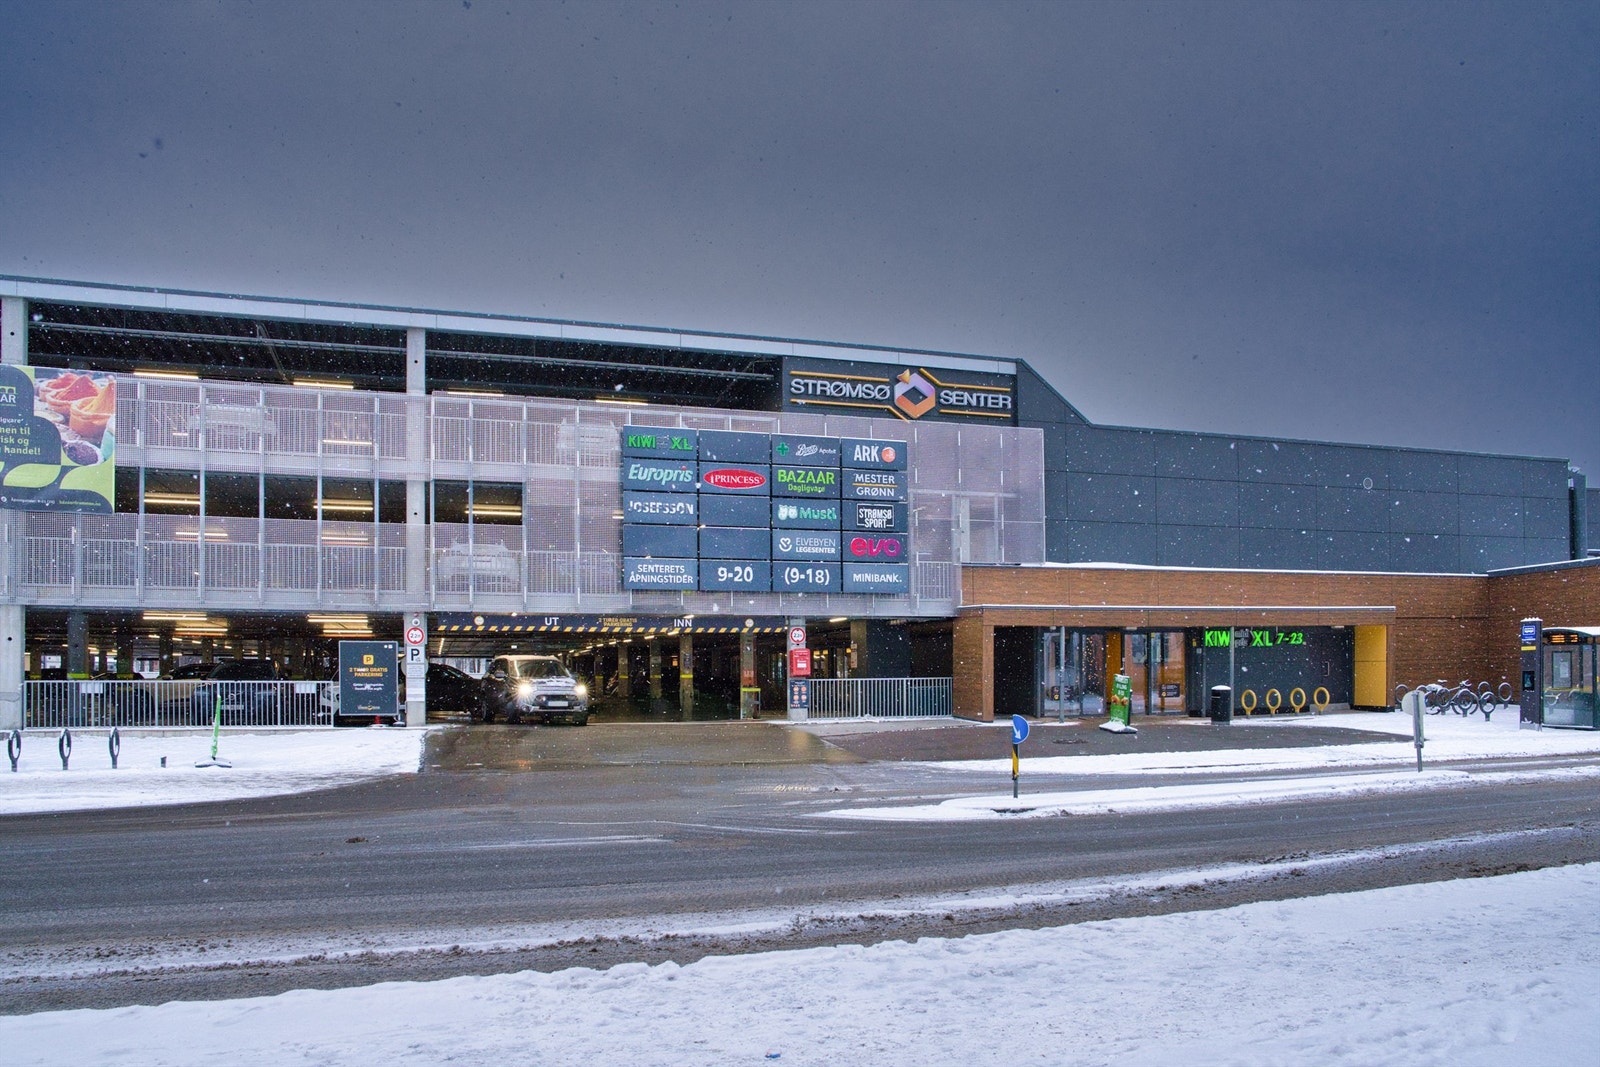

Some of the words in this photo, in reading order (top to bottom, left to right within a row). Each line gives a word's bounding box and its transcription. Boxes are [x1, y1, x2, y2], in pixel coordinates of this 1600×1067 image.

[789, 378, 890, 400] STRØMSØ
[940, 390, 1012, 409] SENTER
[20, 427, 31, 435] til
[17, 438, 29, 446] og
[628, 434, 656, 448] KIWI
[670, 436, 693, 450] XL
[4, 445, 41, 455] handel!
[853, 444, 880, 462] ARK
[628, 464, 693, 485] Europris
[714, 474, 760, 484] PRINCESS
[777, 469, 835, 484] BAZAAR
[854, 473, 895, 484] MESTER
[856, 486, 895, 497] GRØNN
[628, 500, 694, 514] JOSEFSSON
[800, 506, 837, 520] Musti
[858, 508, 892, 519] STRØMSØ
[864, 519, 887, 528] SPORT
[795, 537, 836, 547] ELVEBYEN
[850, 537, 900, 557] evo
[795, 546, 836, 554] LEGESENTER
[637, 564, 685, 573] SENTERETS
[717, 566, 753, 582] 9-20
[629, 571, 694, 583] ÅPNINGSTIDER
[784, 567, 830, 585] (9-18)
[544, 617, 559, 626] UT
[673, 618, 692, 627] INN
[1205, 630, 1230, 647] KIW
[1252, 630, 1273, 646] XL
[1277, 633, 1303, 644] 7-23
[410, 648, 420, 661] P
